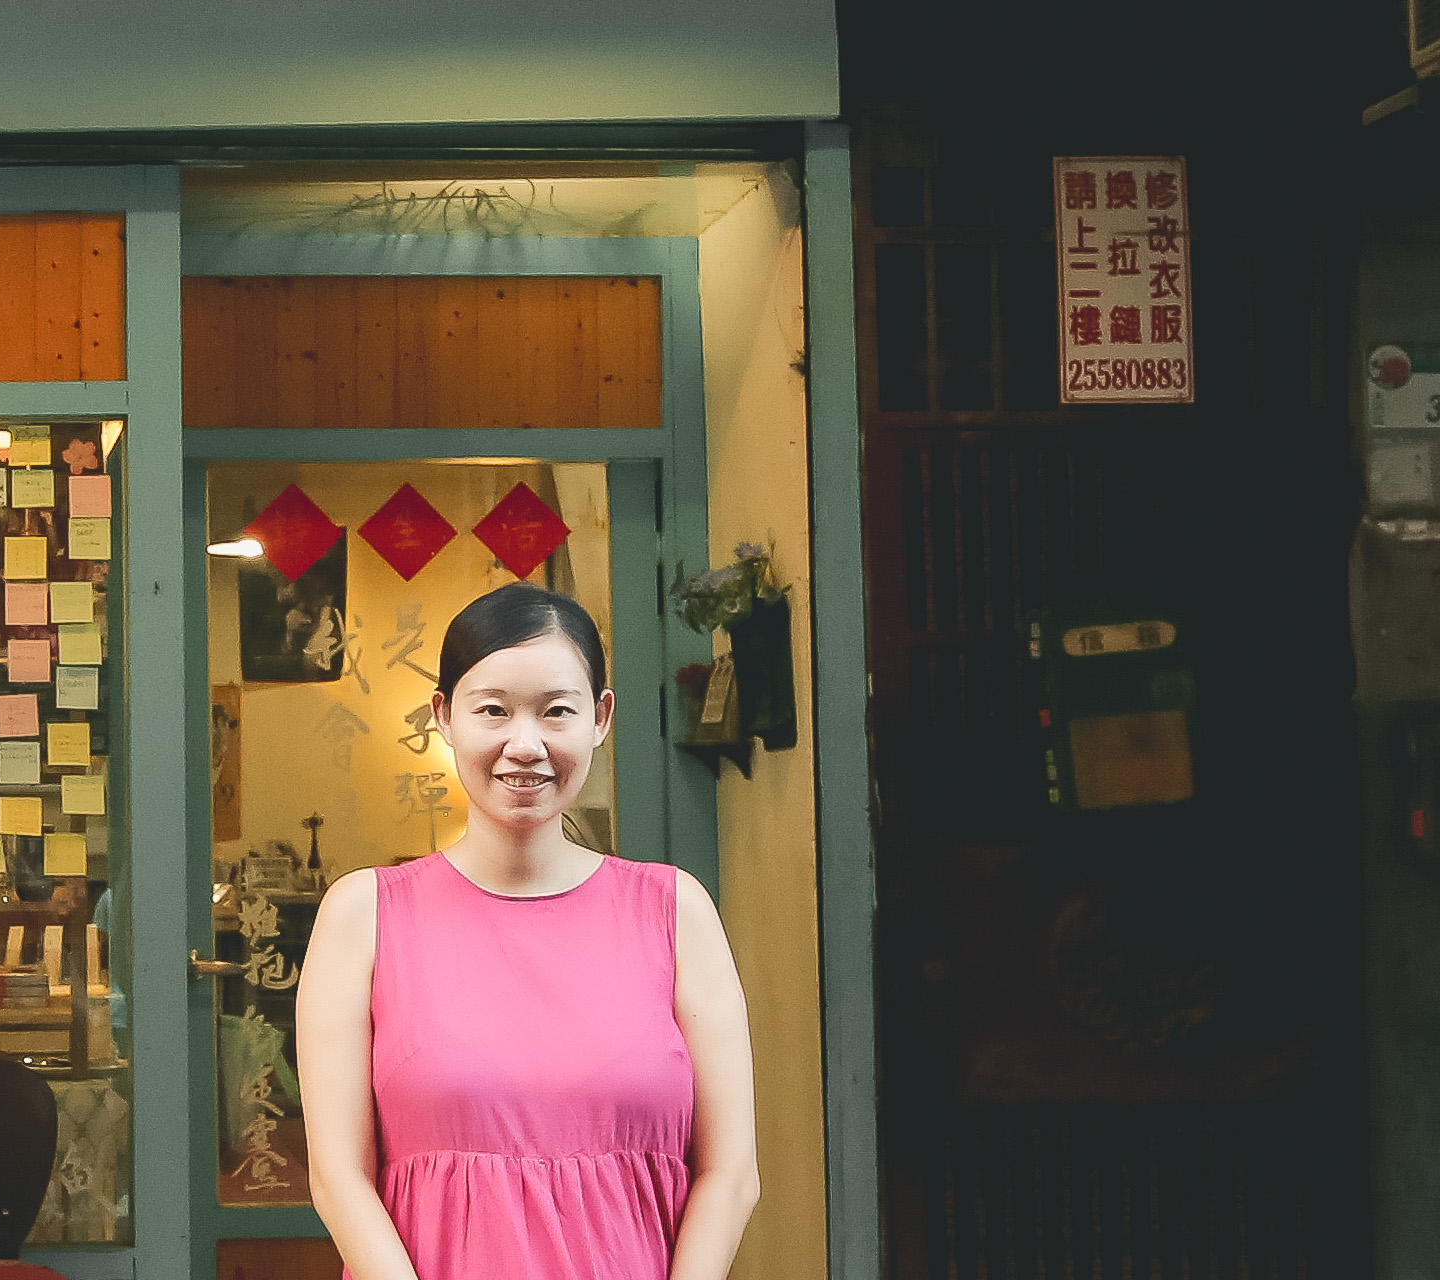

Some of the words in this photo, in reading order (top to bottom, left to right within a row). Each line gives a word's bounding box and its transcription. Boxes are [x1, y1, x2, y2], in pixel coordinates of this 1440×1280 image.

[1065, 171, 1102, 345] 請上二樓
[1146, 170, 1182, 344] 修改衣服
[1069, 358, 1186, 391] 25580883
